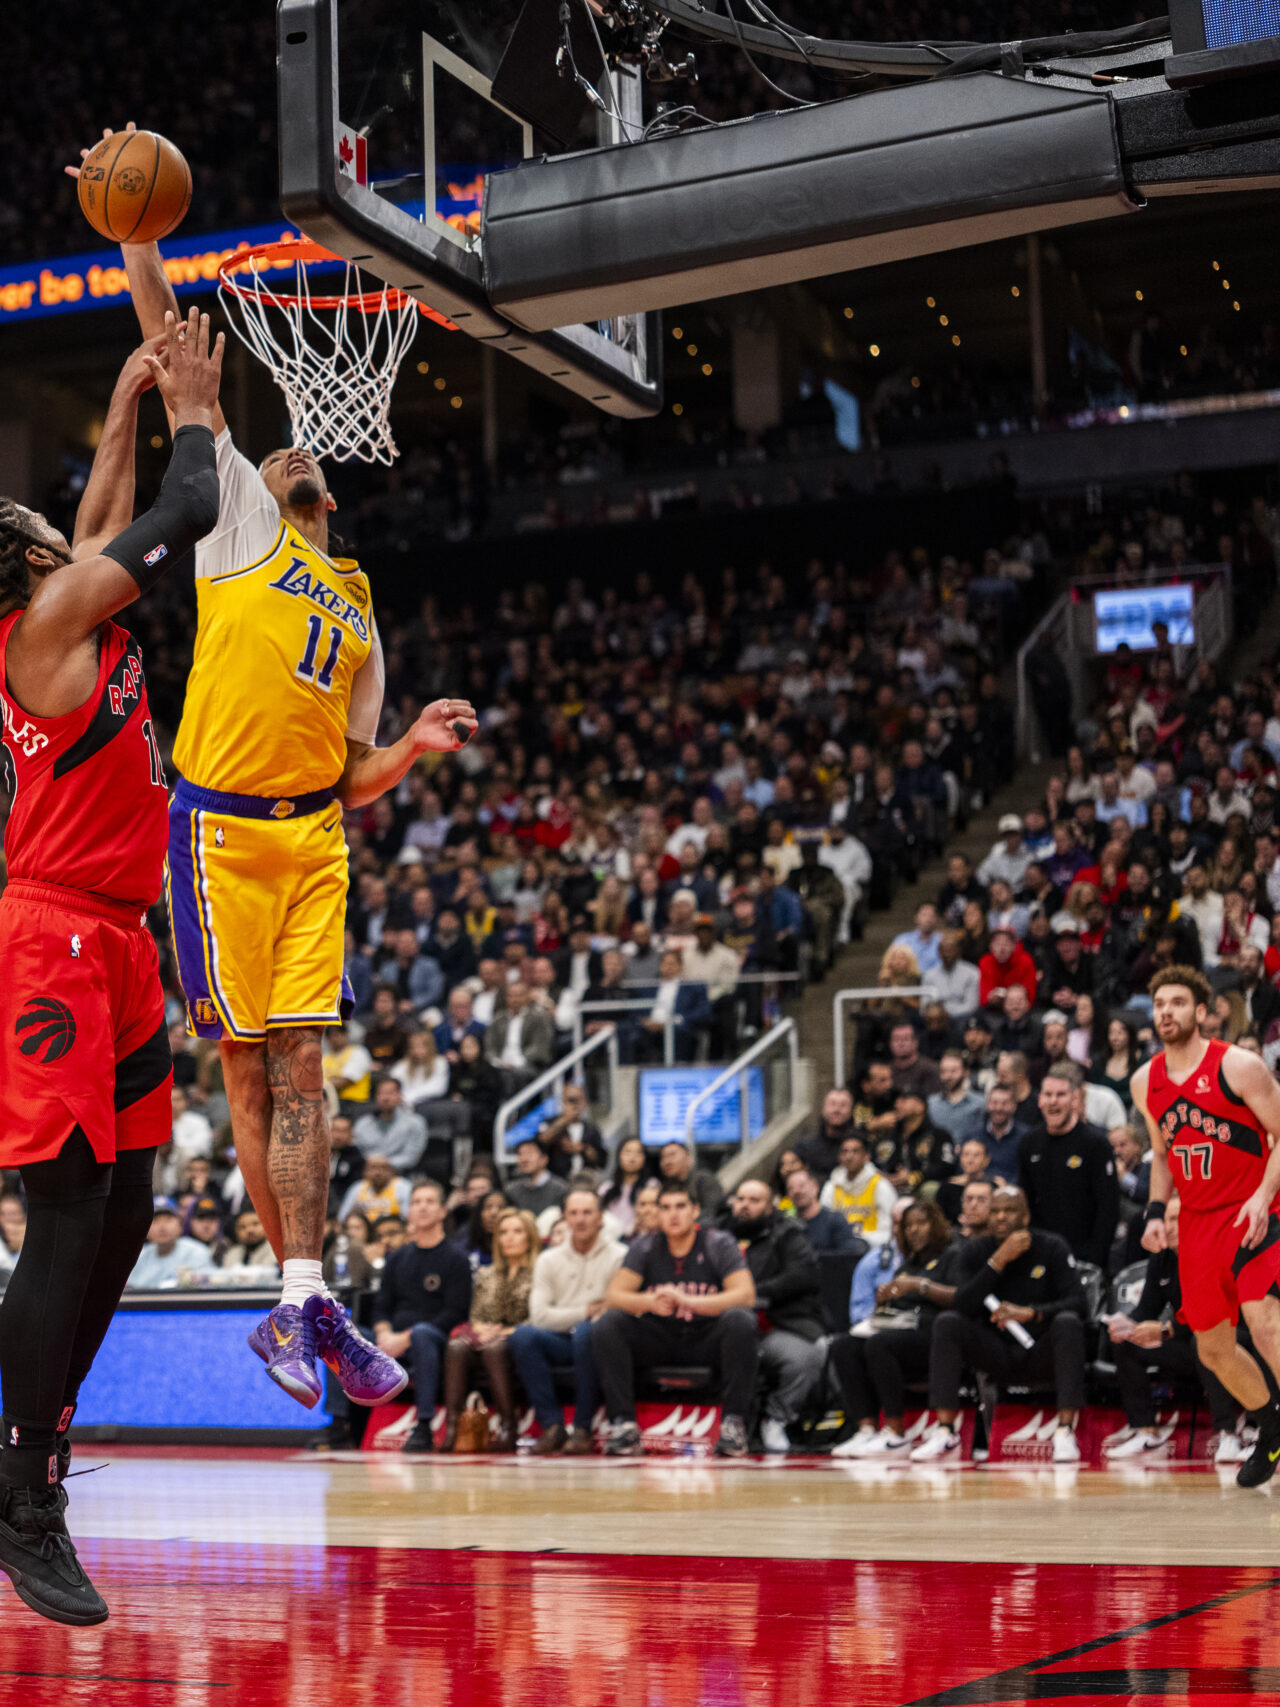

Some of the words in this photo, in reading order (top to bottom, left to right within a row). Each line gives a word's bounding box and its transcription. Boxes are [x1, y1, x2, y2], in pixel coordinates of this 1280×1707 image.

[39, 269, 82, 306] be
[267, 556, 368, 642] LAKERS
[294, 613, 344, 694] 11
[1173, 1141, 1213, 1181] 77
